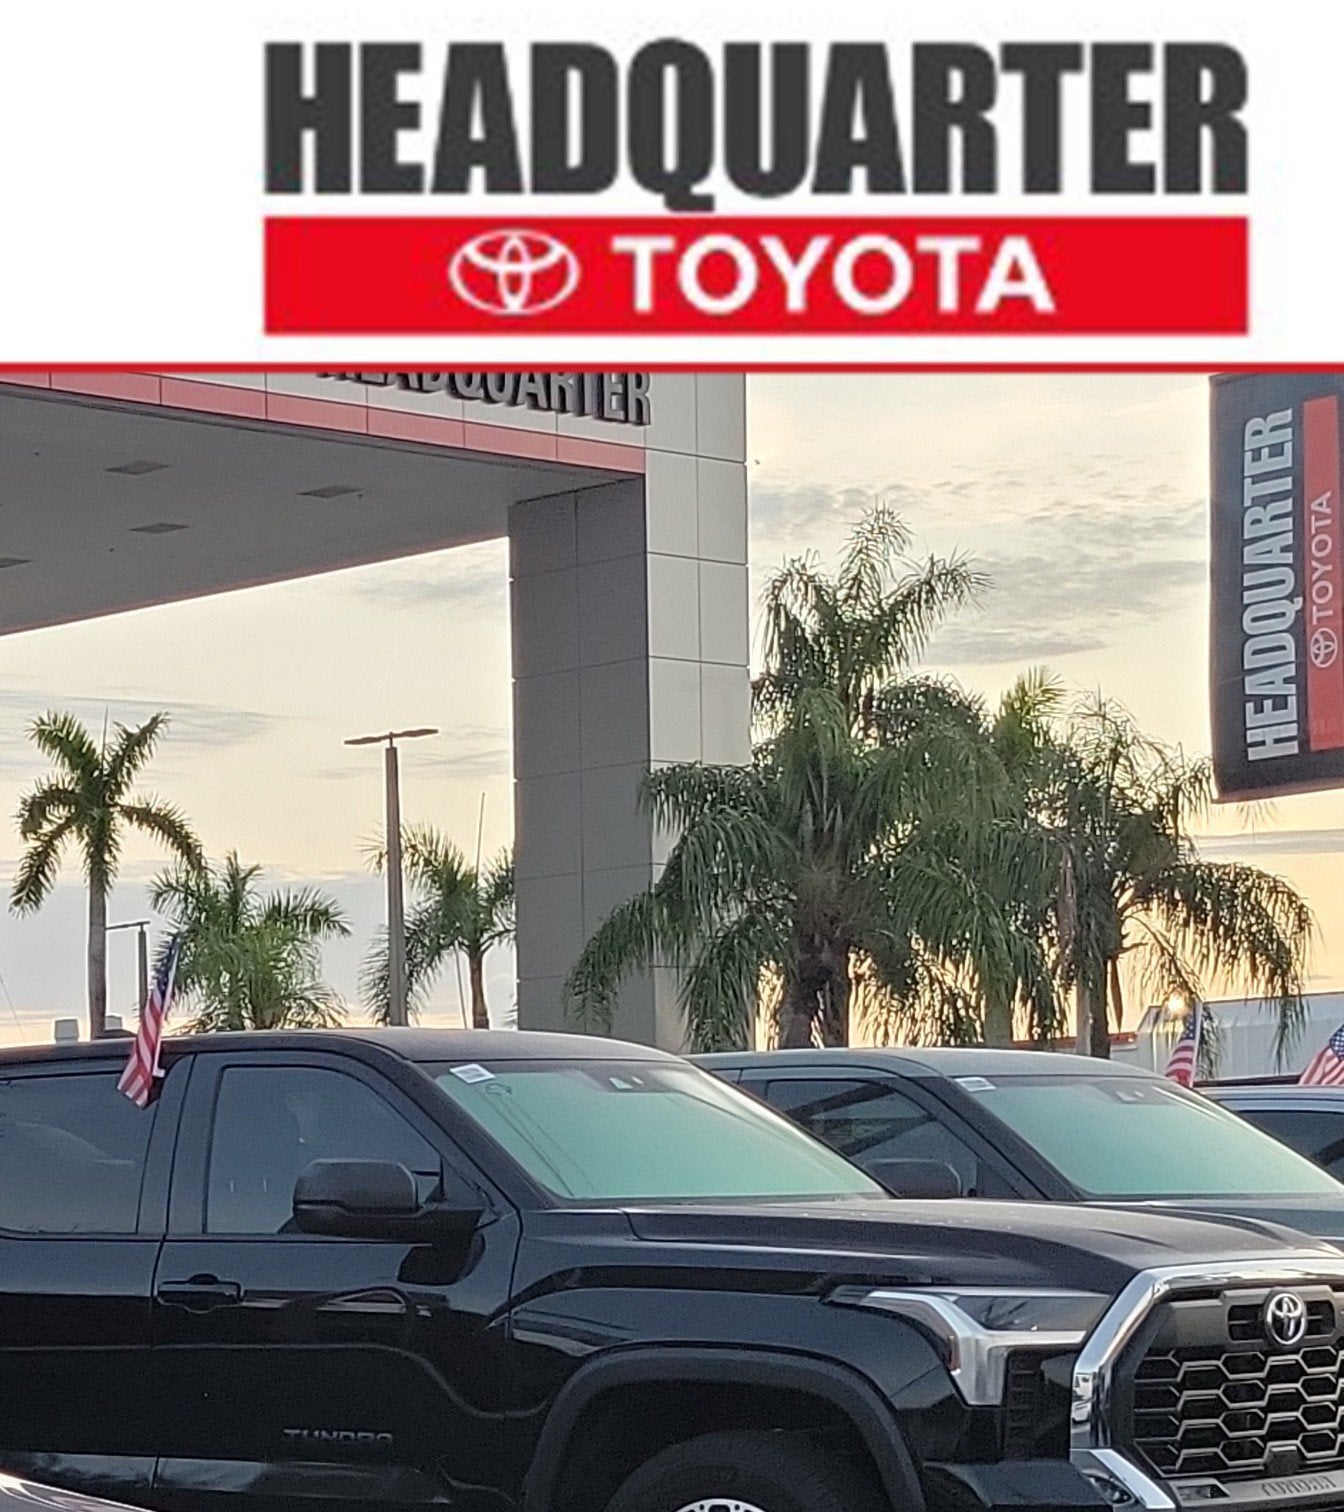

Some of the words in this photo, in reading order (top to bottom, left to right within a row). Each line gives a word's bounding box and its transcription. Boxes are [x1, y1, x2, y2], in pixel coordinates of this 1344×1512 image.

[1242, 408, 1303, 762] HEADQUARTER
[1311, 491, 1333, 626] TOYOTA
[283, 1428, 394, 1444] TUNDRA
